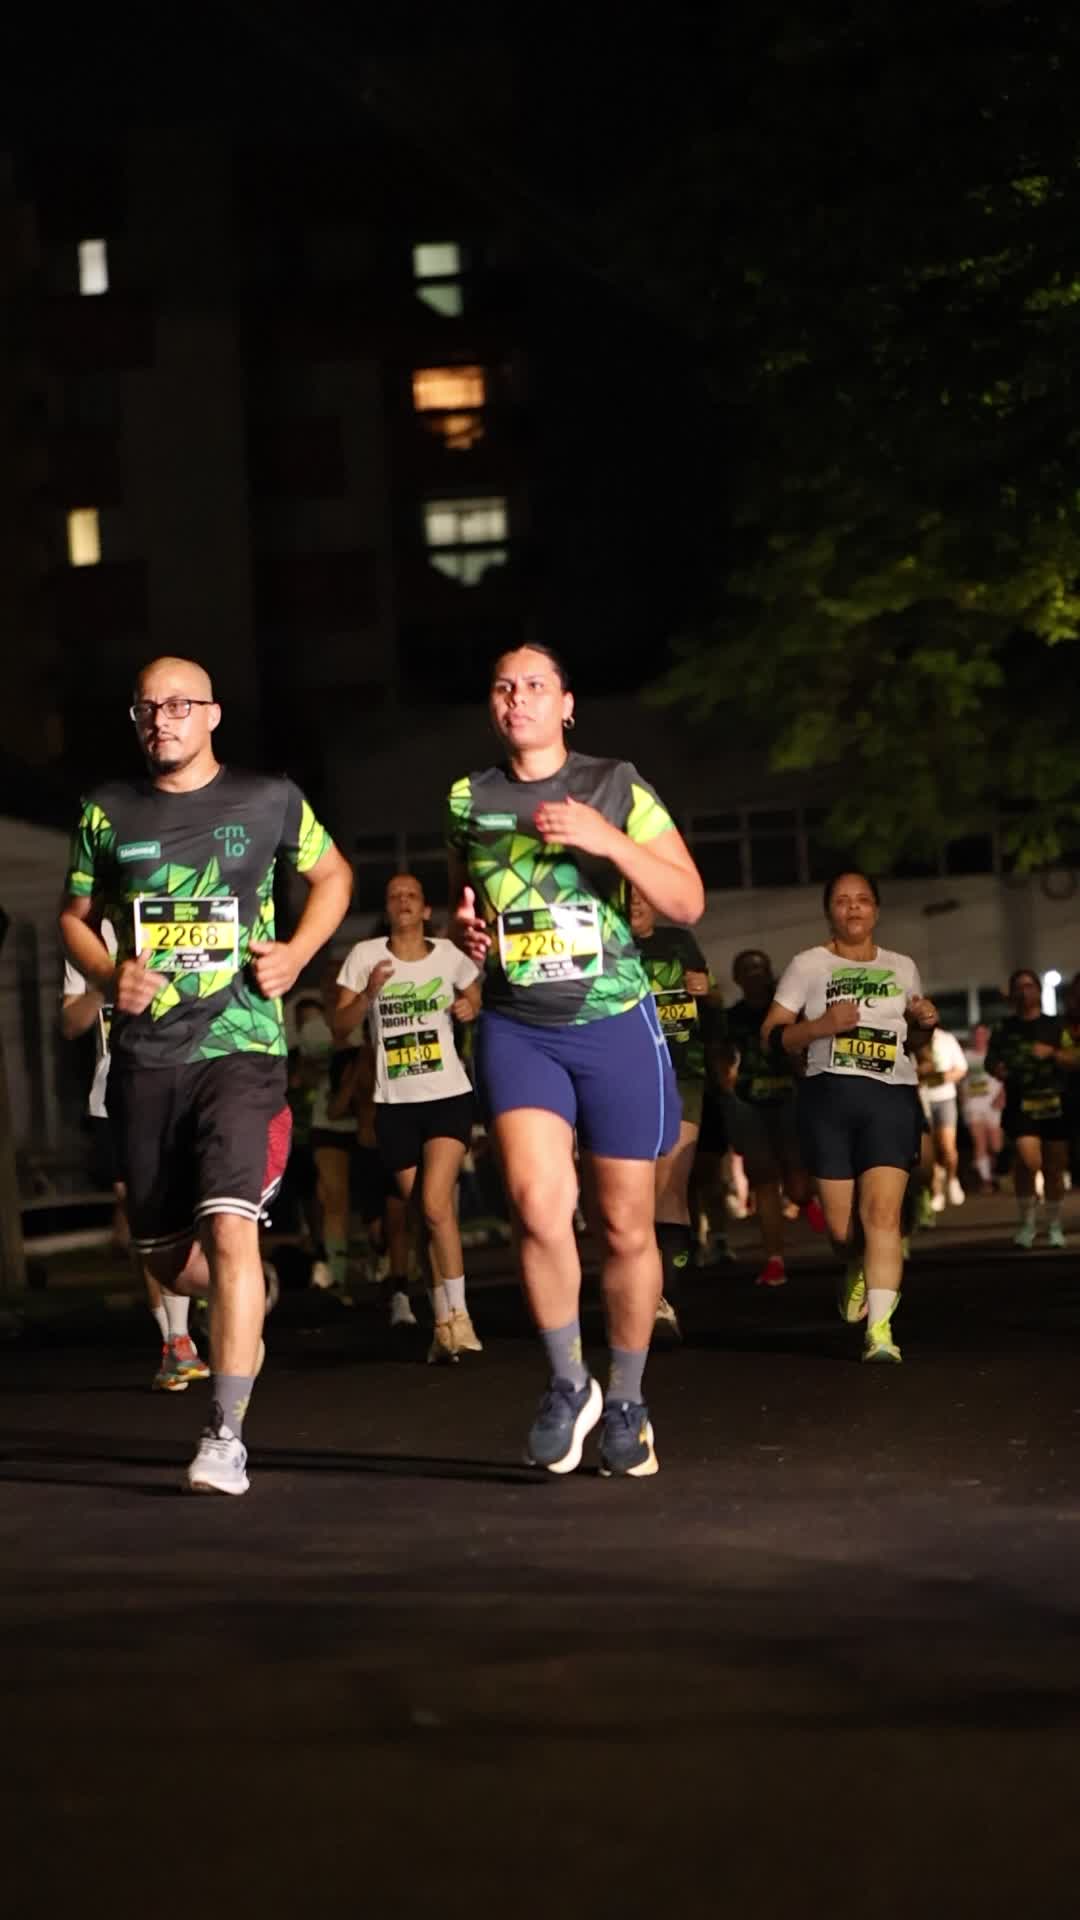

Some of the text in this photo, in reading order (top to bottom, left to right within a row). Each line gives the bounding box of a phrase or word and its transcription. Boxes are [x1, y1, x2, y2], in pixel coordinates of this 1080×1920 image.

[157, 925, 219, 947] 2268
[519, 931, 580, 958] 226
[825, 982, 889, 999] INSPIRA
[379, 999, 438, 1016] INSPIRA
[382, 1014, 414, 1028] NIGHT
[847, 1040, 887, 1058] 1016
